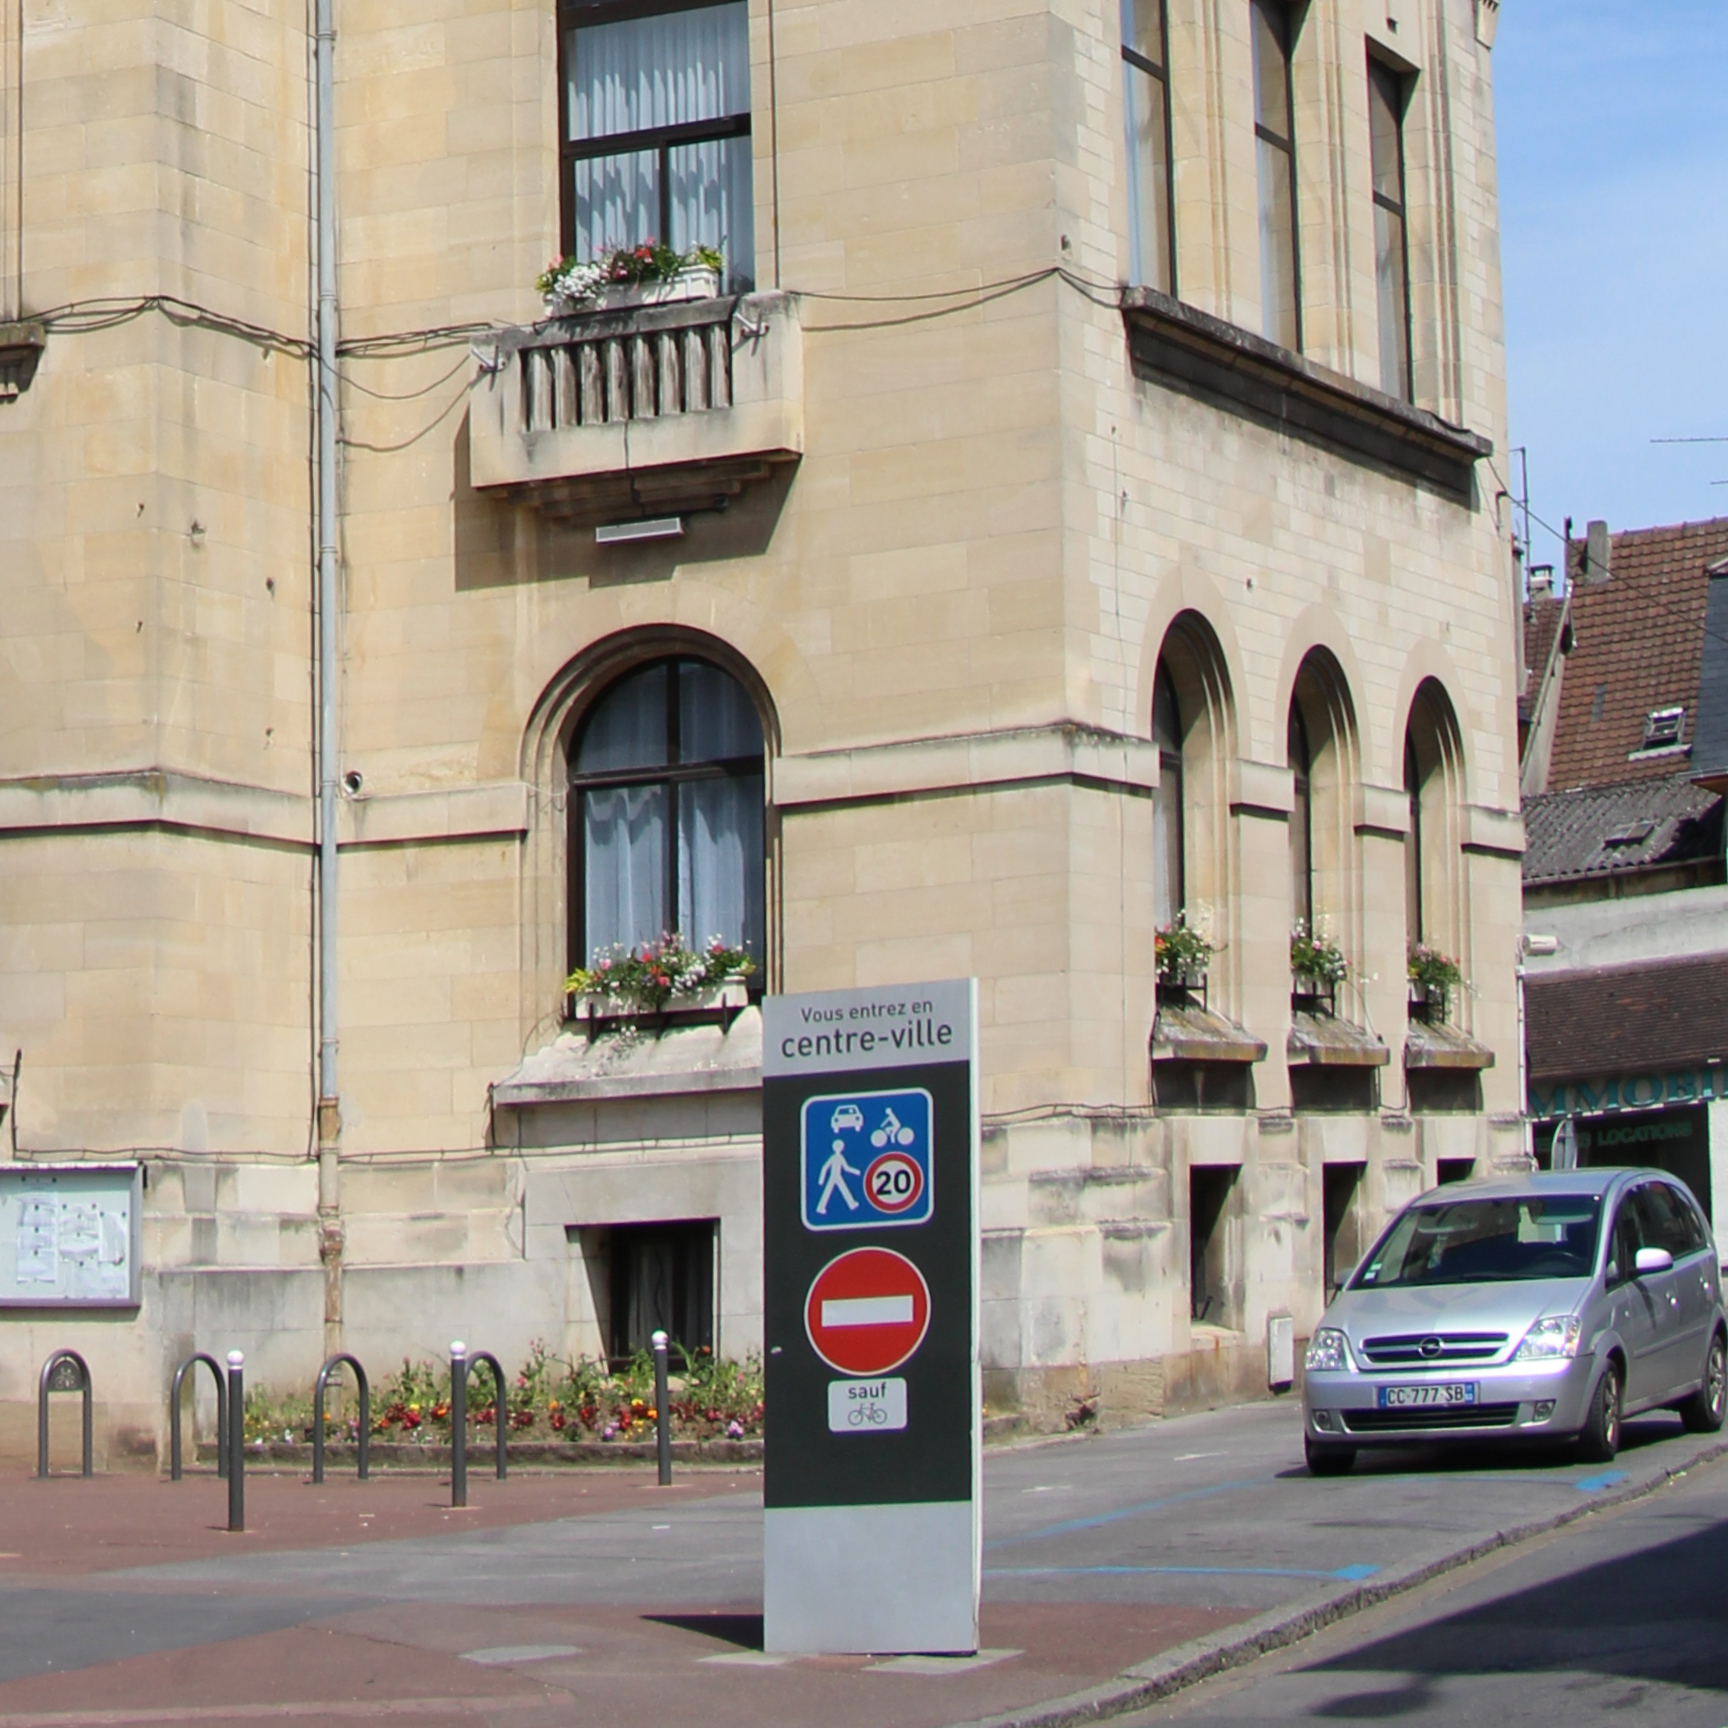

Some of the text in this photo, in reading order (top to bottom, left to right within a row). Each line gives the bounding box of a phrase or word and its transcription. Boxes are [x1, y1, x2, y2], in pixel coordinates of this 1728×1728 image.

[801, 1000, 933, 1023] Vous entrez en
[781, 1018, 952, 1058] centre-ville
[1597, 1119, 1693, 1147] LOCATIONS
[875, 1169, 912, 1195] 20
[848, 1381, 887, 1399] sauf
